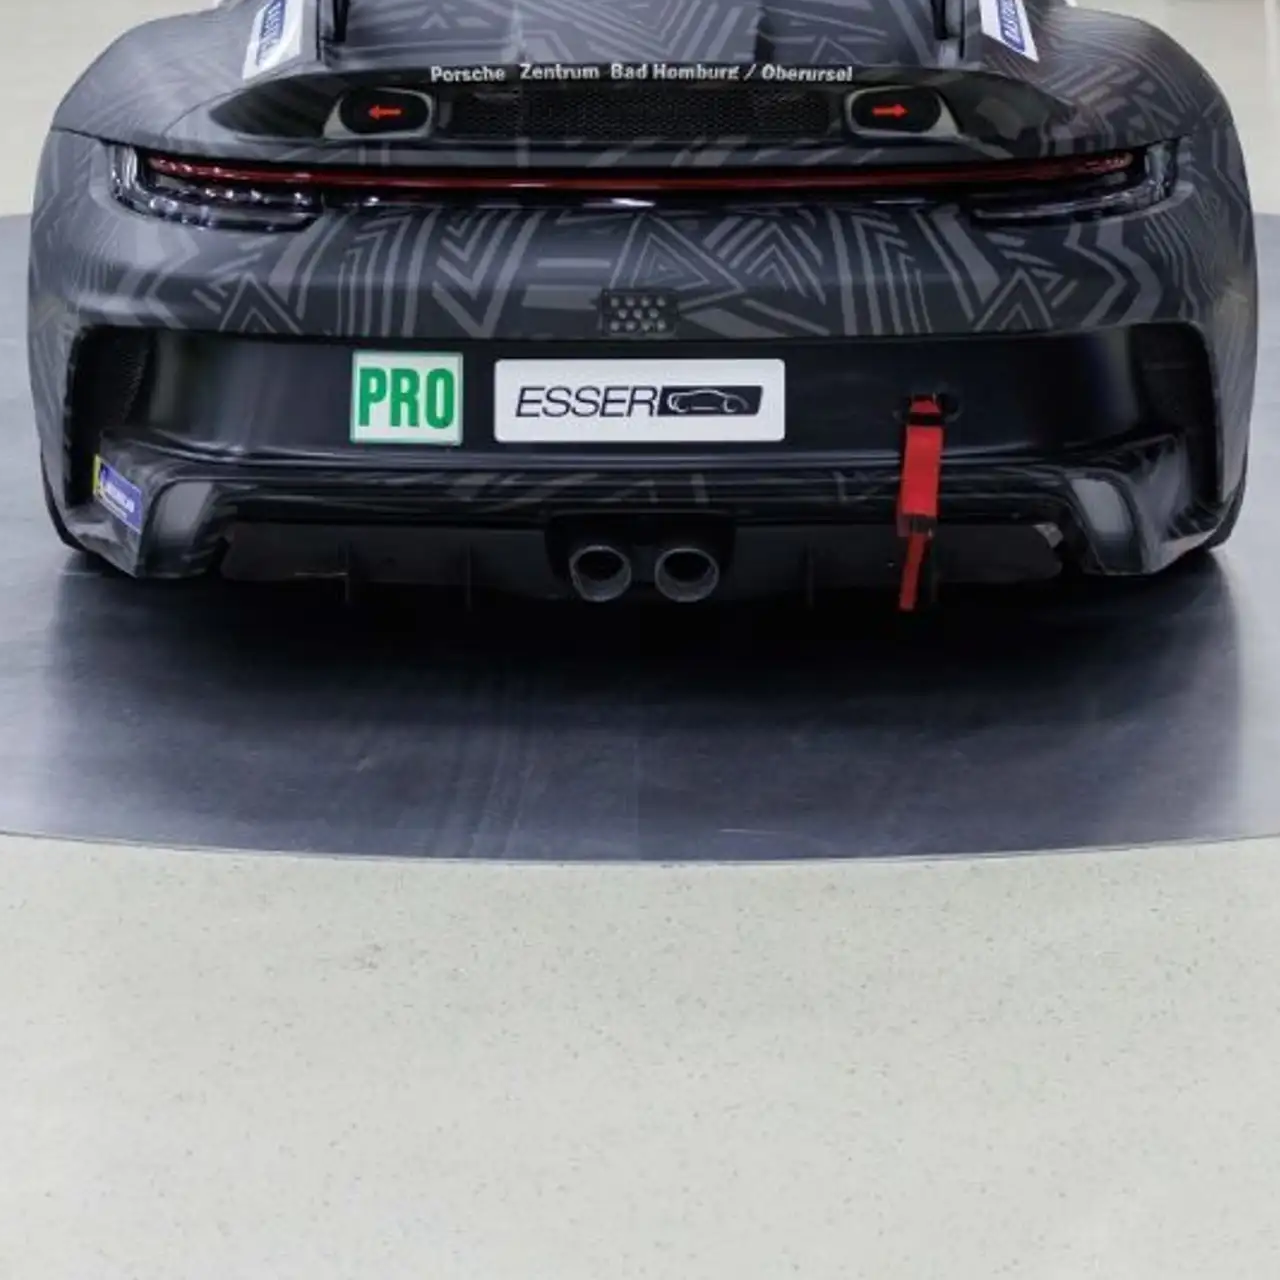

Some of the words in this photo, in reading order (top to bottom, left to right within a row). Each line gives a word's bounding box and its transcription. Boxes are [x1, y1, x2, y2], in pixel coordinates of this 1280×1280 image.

[431, 65, 506, 82] Porsche
[520, 63, 600, 80] Zentrum
[610, 63, 648, 80] Bad
[652, 63, 739, 81] Homburg
[761, 63, 853, 82] Oberursel
[358, 367, 456, 430] PRO
[515, 385, 658, 418] ESSER
